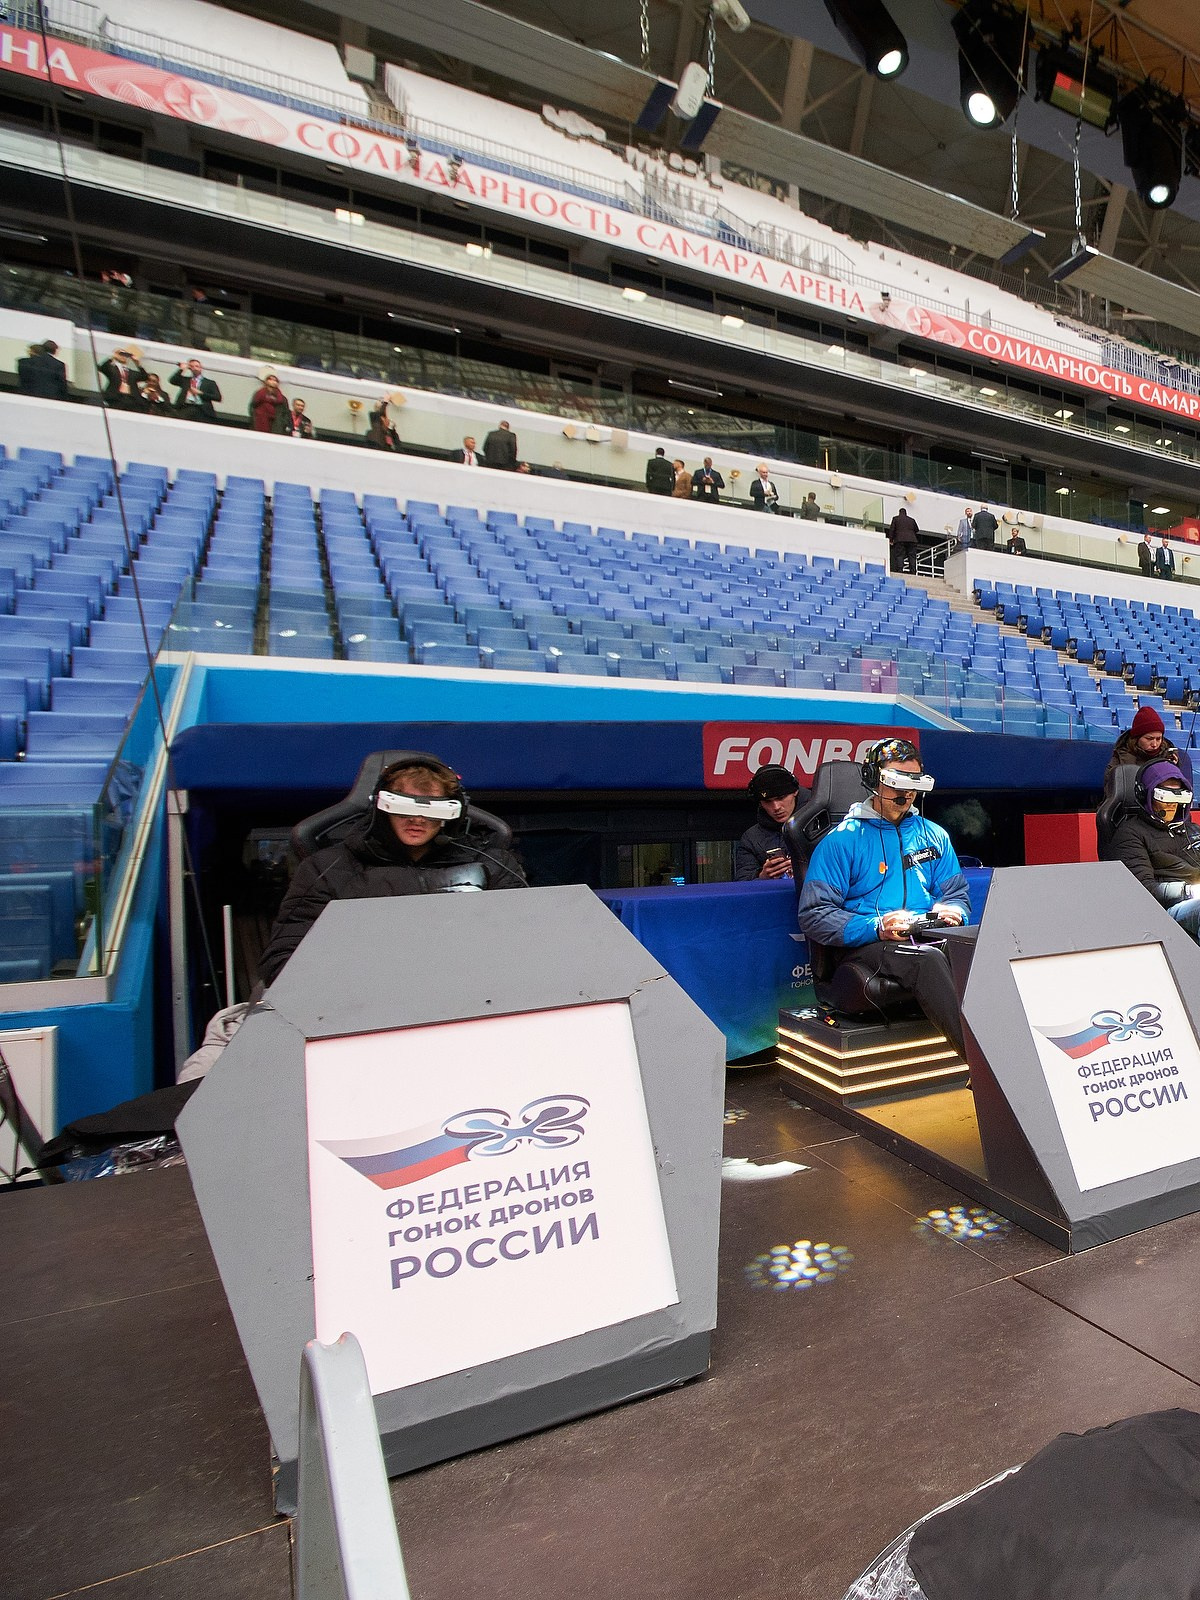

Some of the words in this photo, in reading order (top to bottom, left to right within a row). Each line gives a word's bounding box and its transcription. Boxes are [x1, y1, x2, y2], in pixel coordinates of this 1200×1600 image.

[297, 122, 621, 237] СОЛИДАРНОСТЬ
[637, 224, 768, 284] САМАРА
[780, 271, 865, 313] АРЕНА
[968, 329, 1132, 394] СОЛИДАРНОСТЬ
[1077, 1048, 1174, 1079] ФЕДЕРАЦИЯ
[1083, 1077, 1127, 1096] ГОНОК
[1129, 1066, 1179, 1087] ДРОНОВ
[1088, 1081, 1188, 1122] РОССИИ
[386, 1161, 591, 1219] ФЕДЕРАЦИЯ
[388, 1212, 480, 1247] ГОНОК
[489, 1188, 594, 1227] ДРОНОВ
[390, 1212, 600, 1290] РОССИИ
